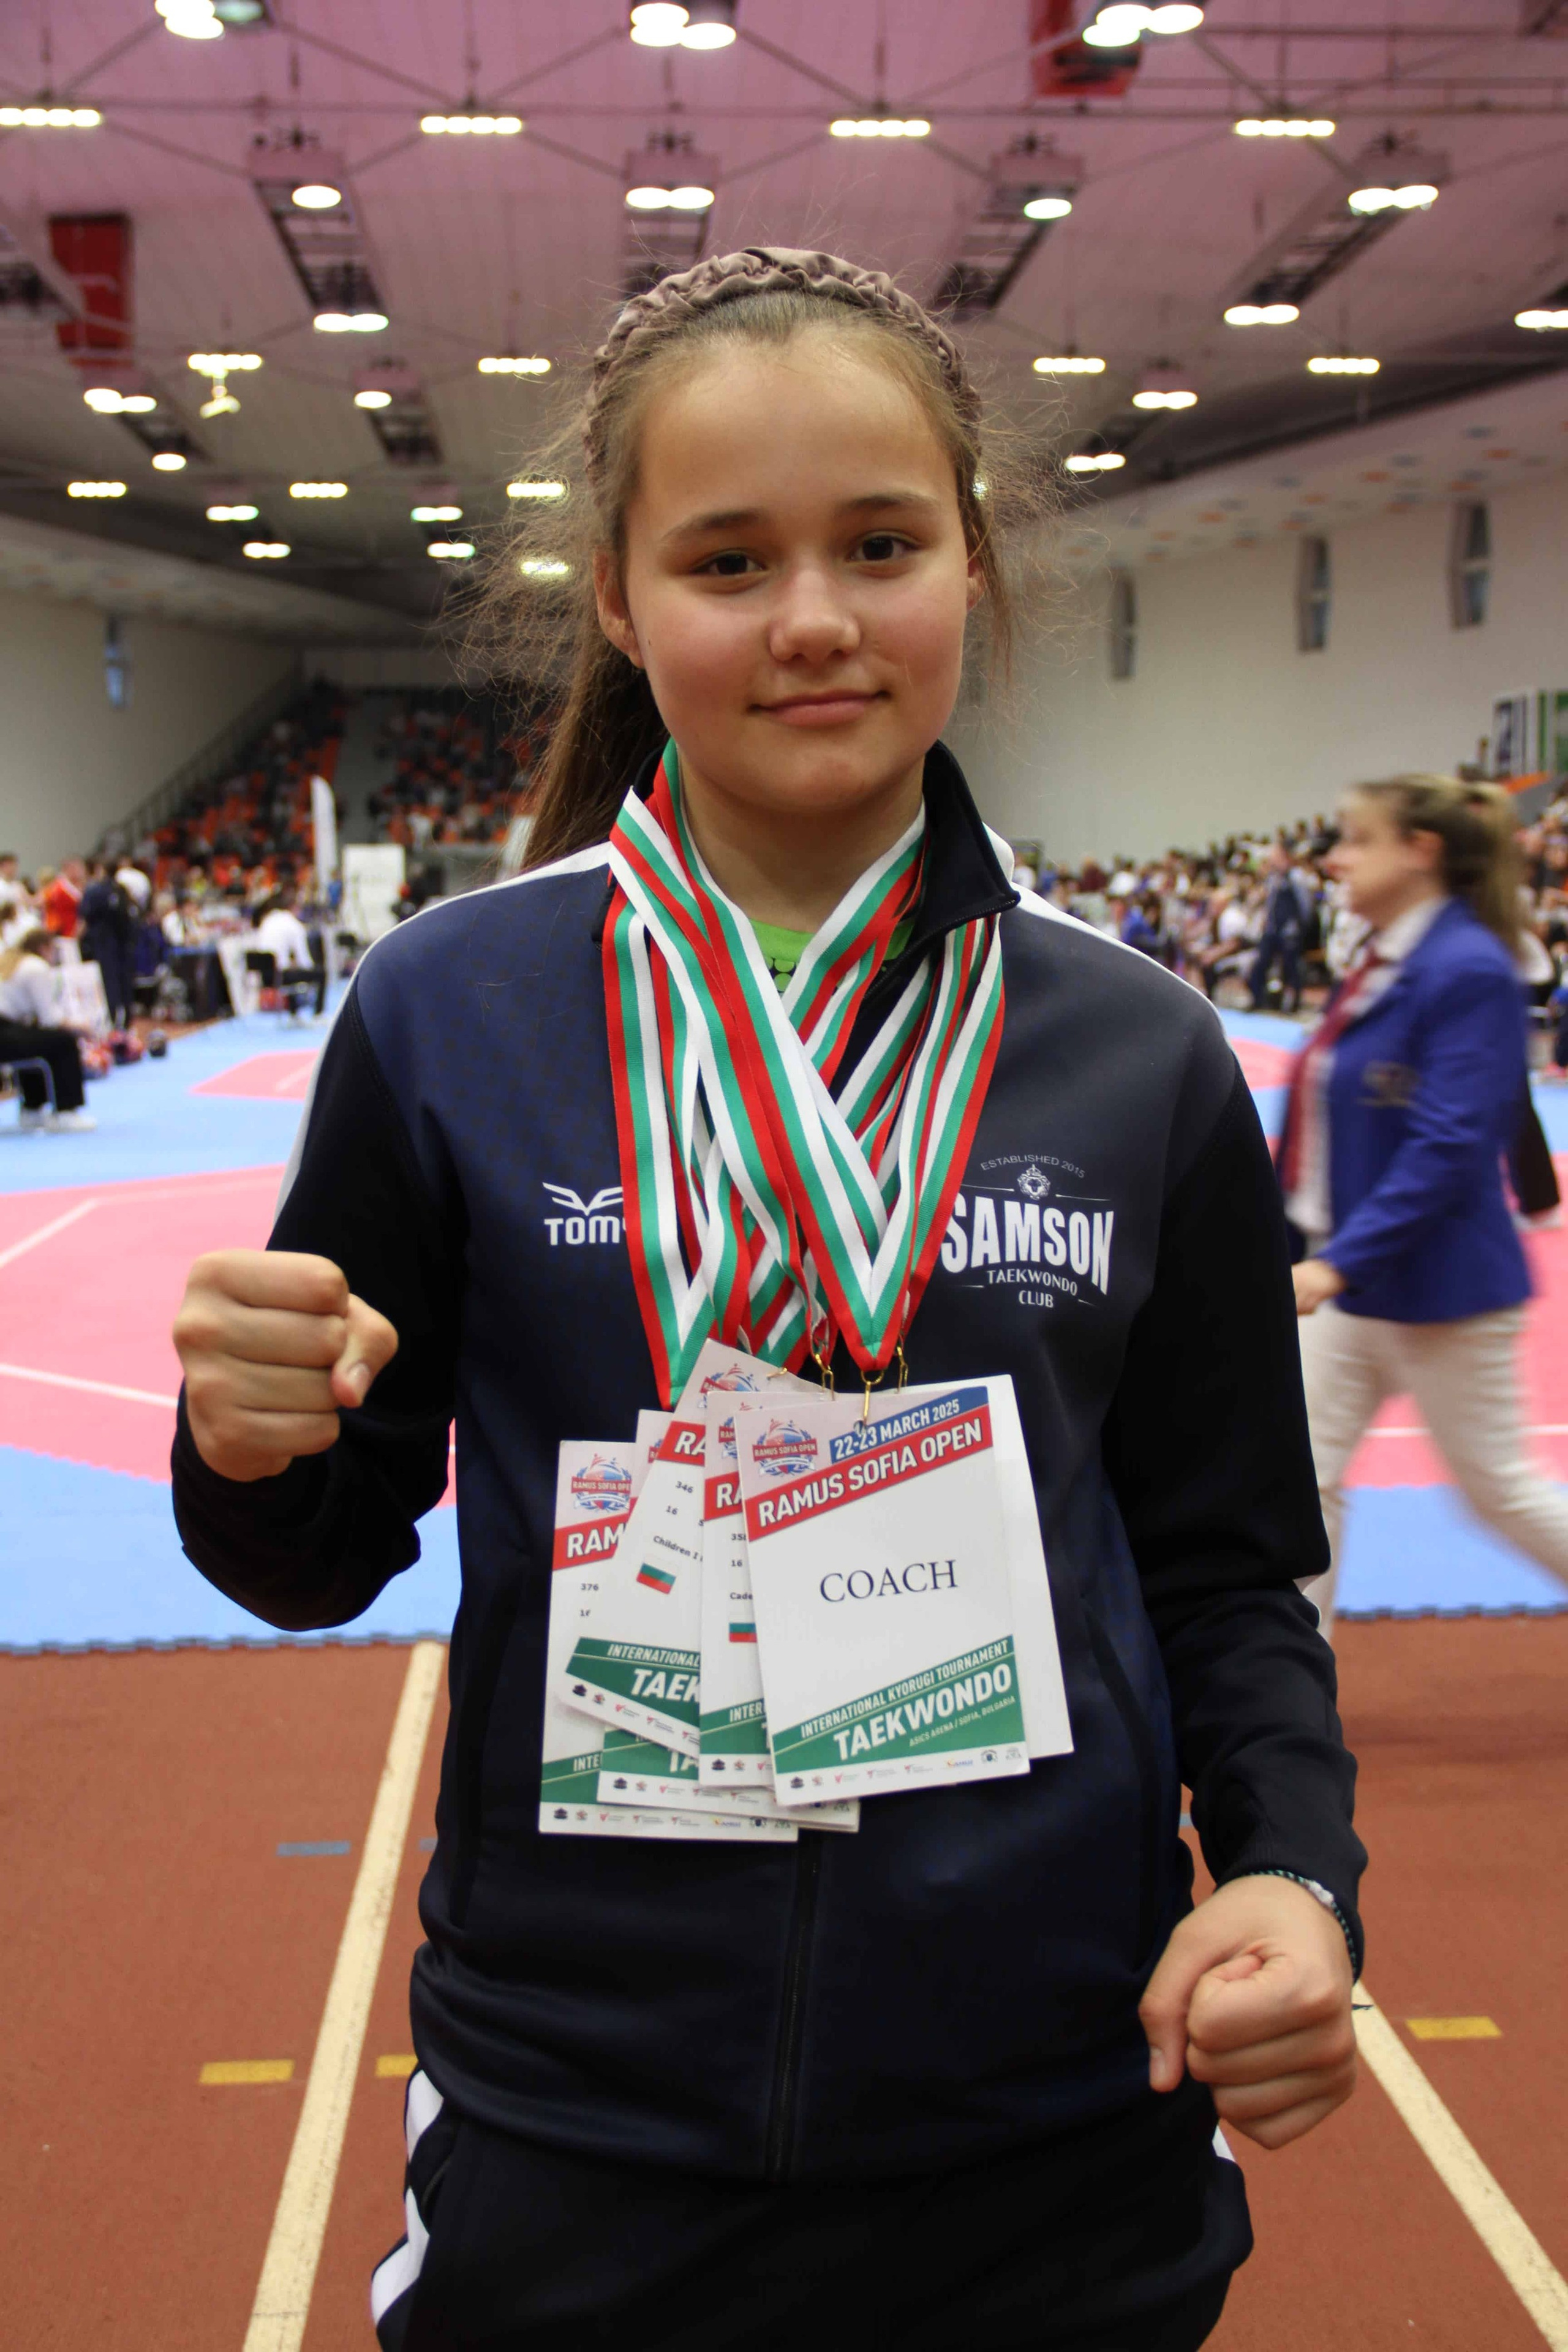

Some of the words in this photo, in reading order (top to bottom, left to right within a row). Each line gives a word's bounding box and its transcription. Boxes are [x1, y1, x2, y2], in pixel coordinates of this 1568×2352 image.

[980, 1155, 1059, 1170] ESTABLISHED
[1061, 1161, 1085, 1178] 2015
[544, 1215, 627, 1246] TOM
[941, 1193, 1114, 1295] SAMSON
[987, 1268, 1077, 1296] TAEKWONDO
[1019, 1290, 1054, 1308] CLUB
[835, 1426, 877, 1460] 22-23
[880, 1409, 930, 1442] MARCH
[933, 1399, 959, 1422] 2025
[755, 1447, 778, 1457] RAMUS
[778, 1446, 798, 1455] SOFIA
[798, 1443, 815, 1452] OPEN
[758, 1474, 845, 1527] RAMUS
[848, 1445, 918, 1491] SOFIA
[921, 1418, 982, 1462] OPEN
[676, 1481, 693, 1493] 346
[666, 1506, 678, 1515] 16
[653, 1536, 690, 1556] Children
[581, 1583, 599, 1591] 376
[819, 1559, 959, 1602] COACH
[607, 1644, 700, 1667] INTERNATIONAL
[801, 1693, 886, 1738] INTERNATIONAL
[888, 1673, 935, 1702] KYORUGI
[937, 1639, 1008, 1679] TOURNAMENT
[833, 1663, 1012, 1761] TAEKWONDO
[573, 1753, 602, 1772] INTE
